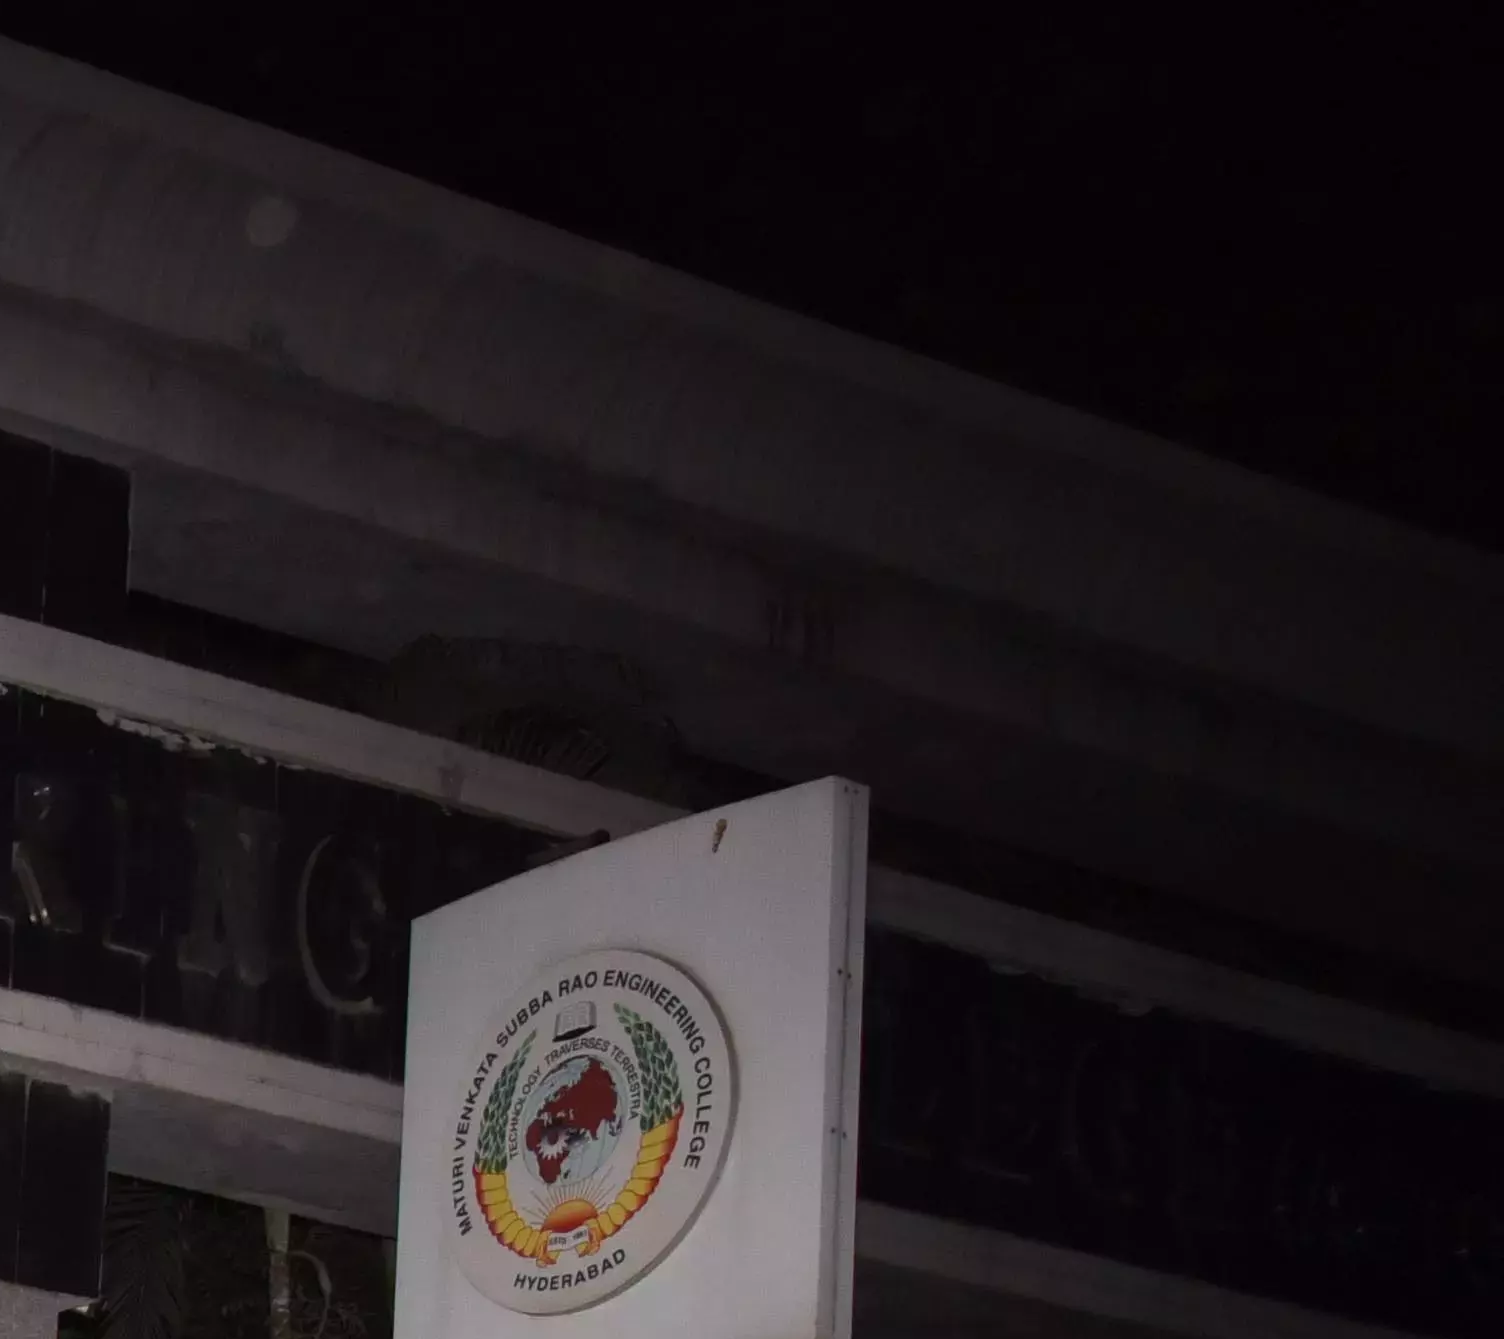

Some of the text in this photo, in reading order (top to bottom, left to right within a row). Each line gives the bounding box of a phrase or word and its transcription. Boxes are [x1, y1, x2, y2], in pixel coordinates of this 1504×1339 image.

[451, 969, 714, 1236] MATURI VENKATA SUBBA RAO ENGINEERING COLLEGE
[509, 1067, 544, 1160] TECHNOLOGY
[544, 1036, 611, 1067] TRAVERSES
[513, 1247, 627, 1292] HYDERABAD
